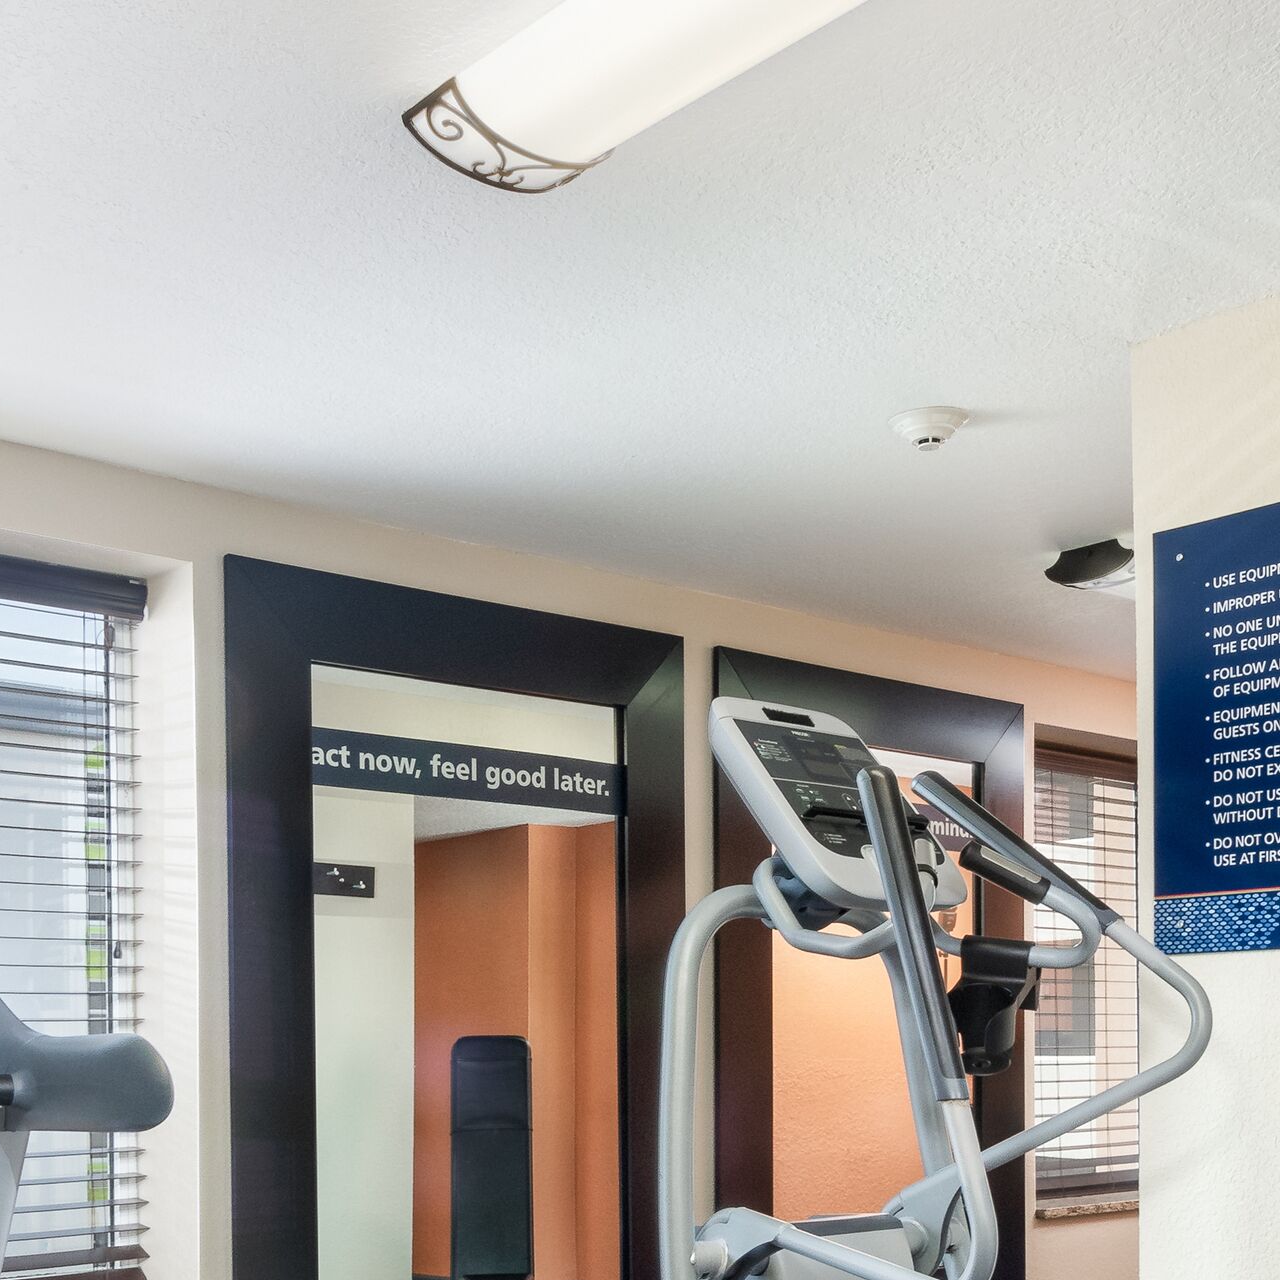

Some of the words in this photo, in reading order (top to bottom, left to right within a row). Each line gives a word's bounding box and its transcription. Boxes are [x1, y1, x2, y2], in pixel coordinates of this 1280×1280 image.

[1213, 573, 1236, 588] USE
[1213, 590, 1276, 614] IMPROPER
[1213, 625, 1233, 639] NO
[1236, 618, 1263, 634] ONE
[1213, 641, 1237, 656] THE
[1213, 661, 1266, 681] FOLLOW
[1213, 684, 1230, 698] OF
[1213, 722, 1260, 740] GUESTS
[1213, 748, 1261, 765] FITNESS
[312, 745, 351, 769] act
[359, 752, 422, 779] now,
[429, 753, 477, 781] feel
[485, 765, 546, 790] good
[553, 767, 610, 796] later.
[1214, 769, 1233, 782] DO
[1236, 765, 1264, 779] NOT
[1214, 794, 1233, 807] DO
[1236, 790, 1263, 805] NOT
[1213, 807, 1274, 824] WITHOUT
[1214, 837, 1232, 850] DO
[1235, 834, 1262, 847] NOT
[1214, 854, 1236, 867] USE
[1239, 852, 1256, 865] AT
